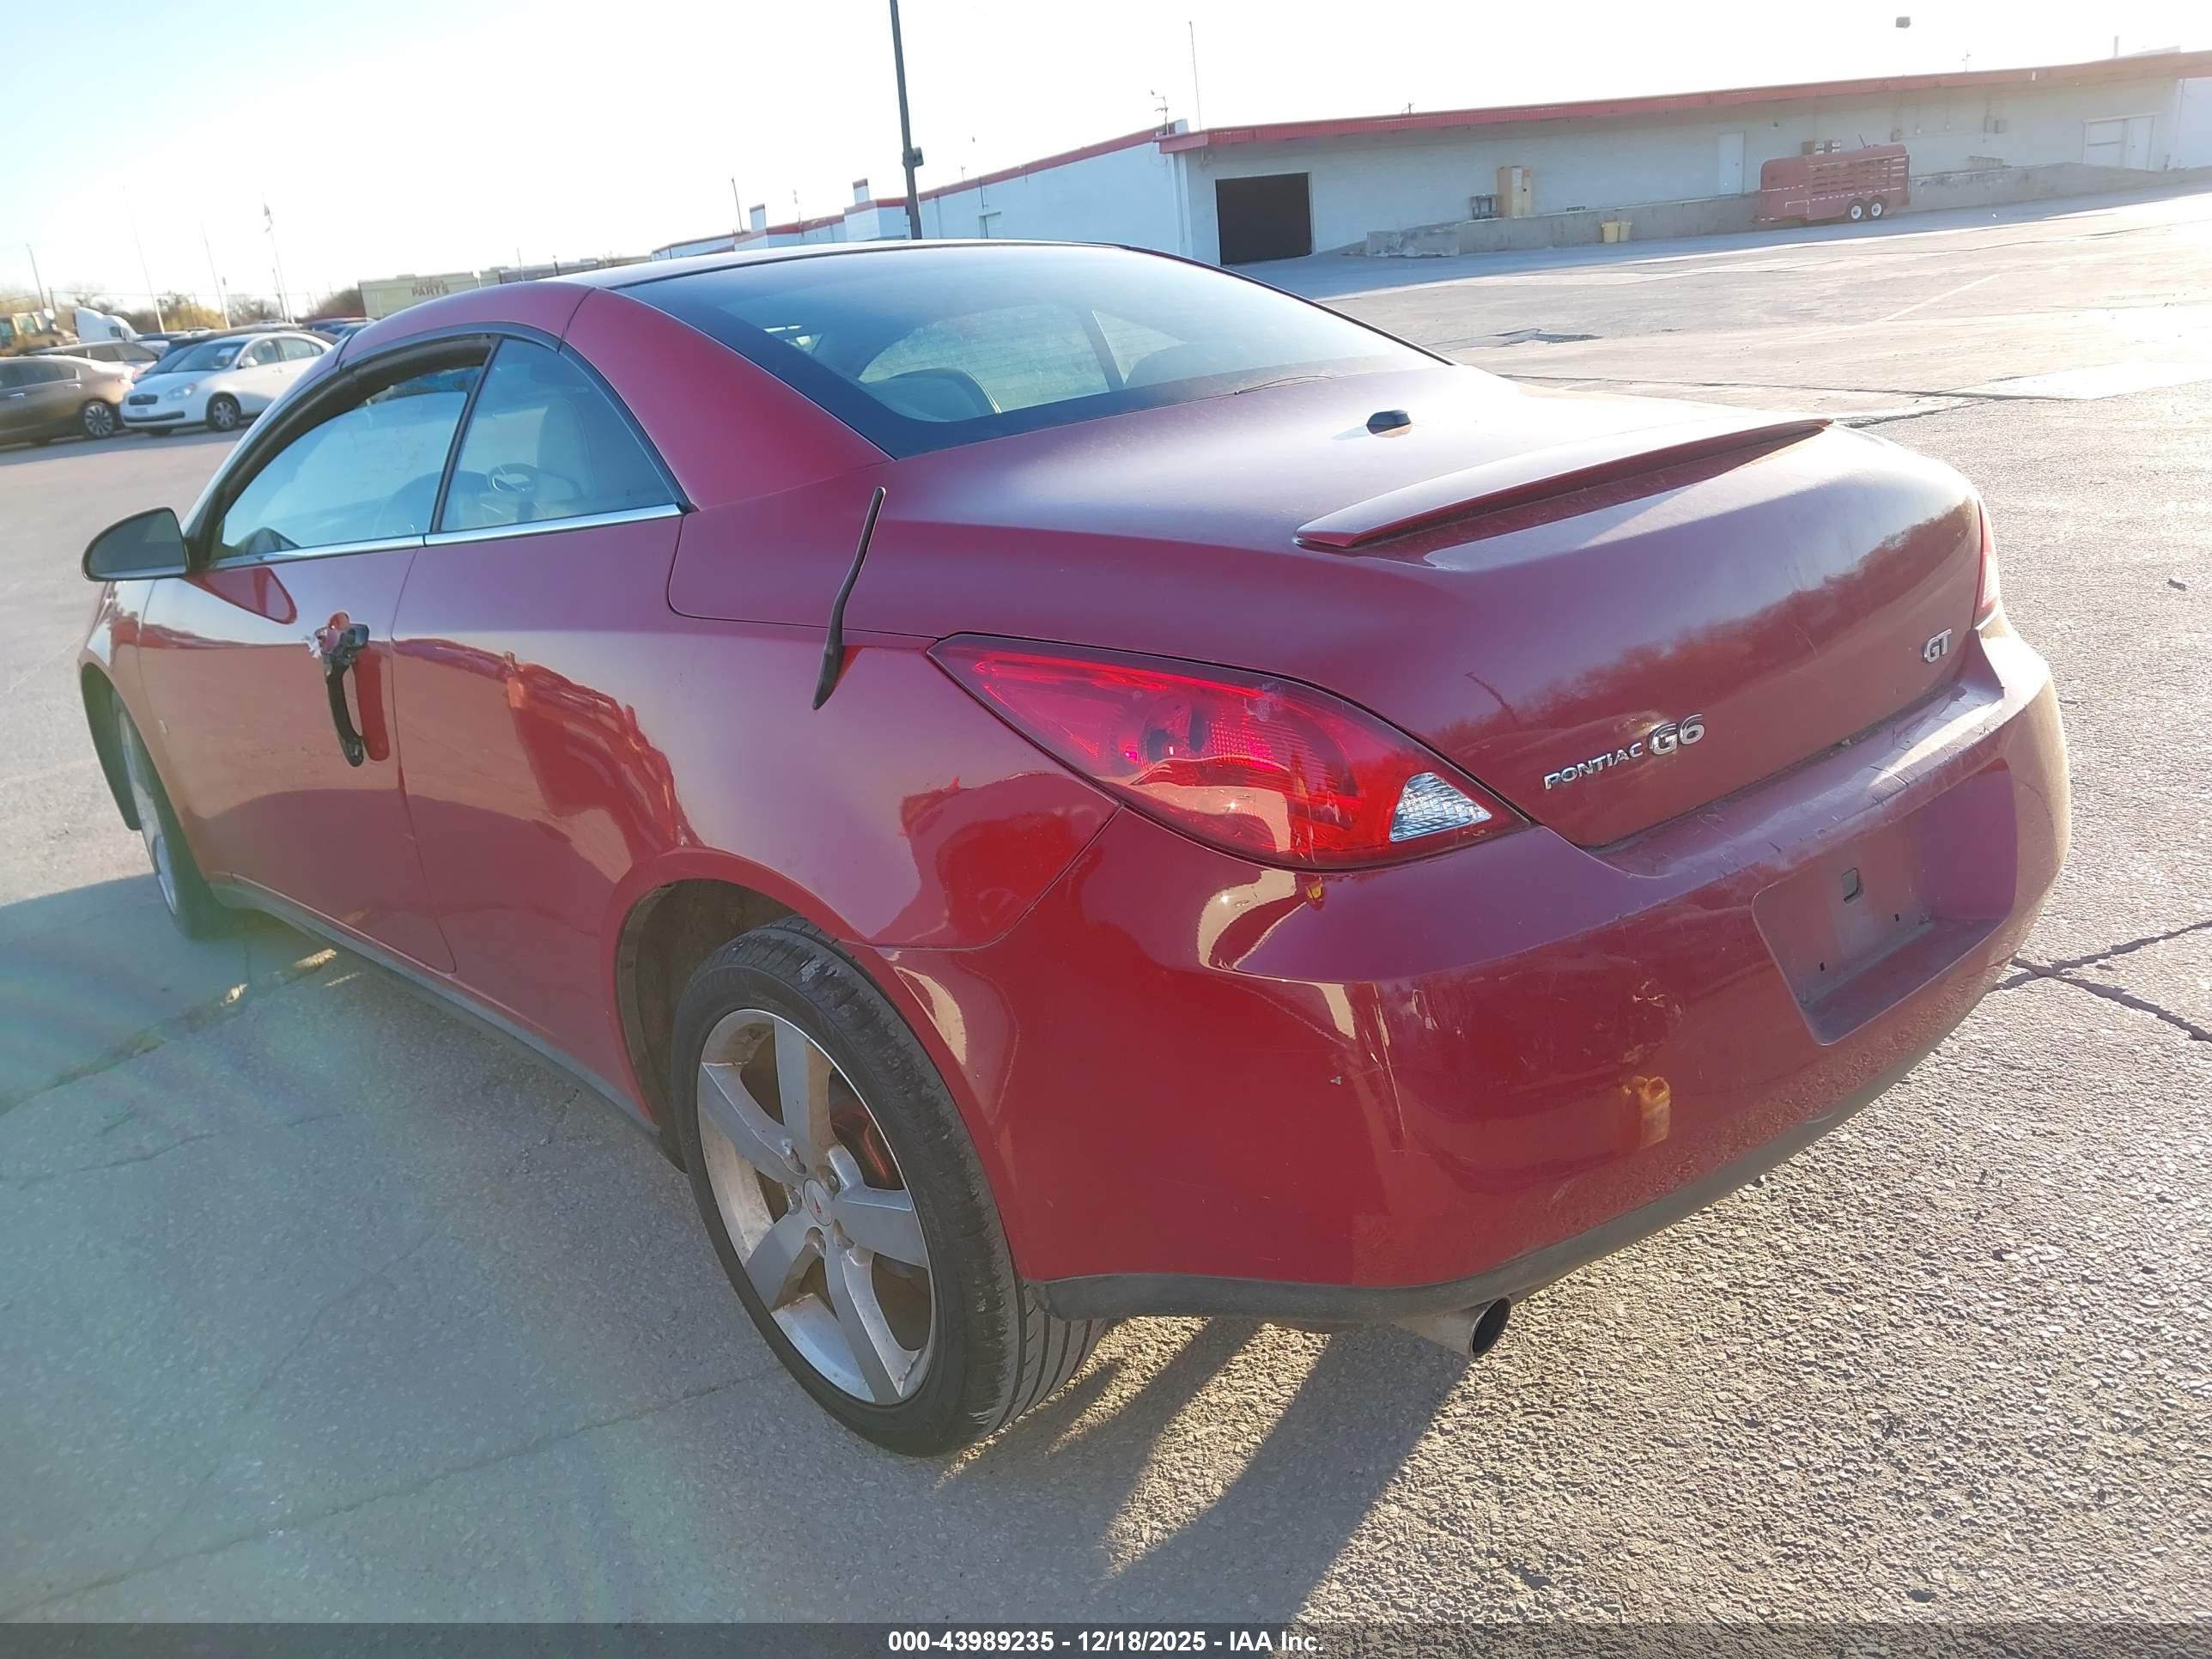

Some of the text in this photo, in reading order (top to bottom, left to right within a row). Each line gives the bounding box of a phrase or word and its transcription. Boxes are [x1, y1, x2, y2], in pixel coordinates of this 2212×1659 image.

[411, 283, 450, 296] PARTS
[1923, 628, 1952, 663] GT
[1543, 714, 1705, 790] PONTIAC G6
